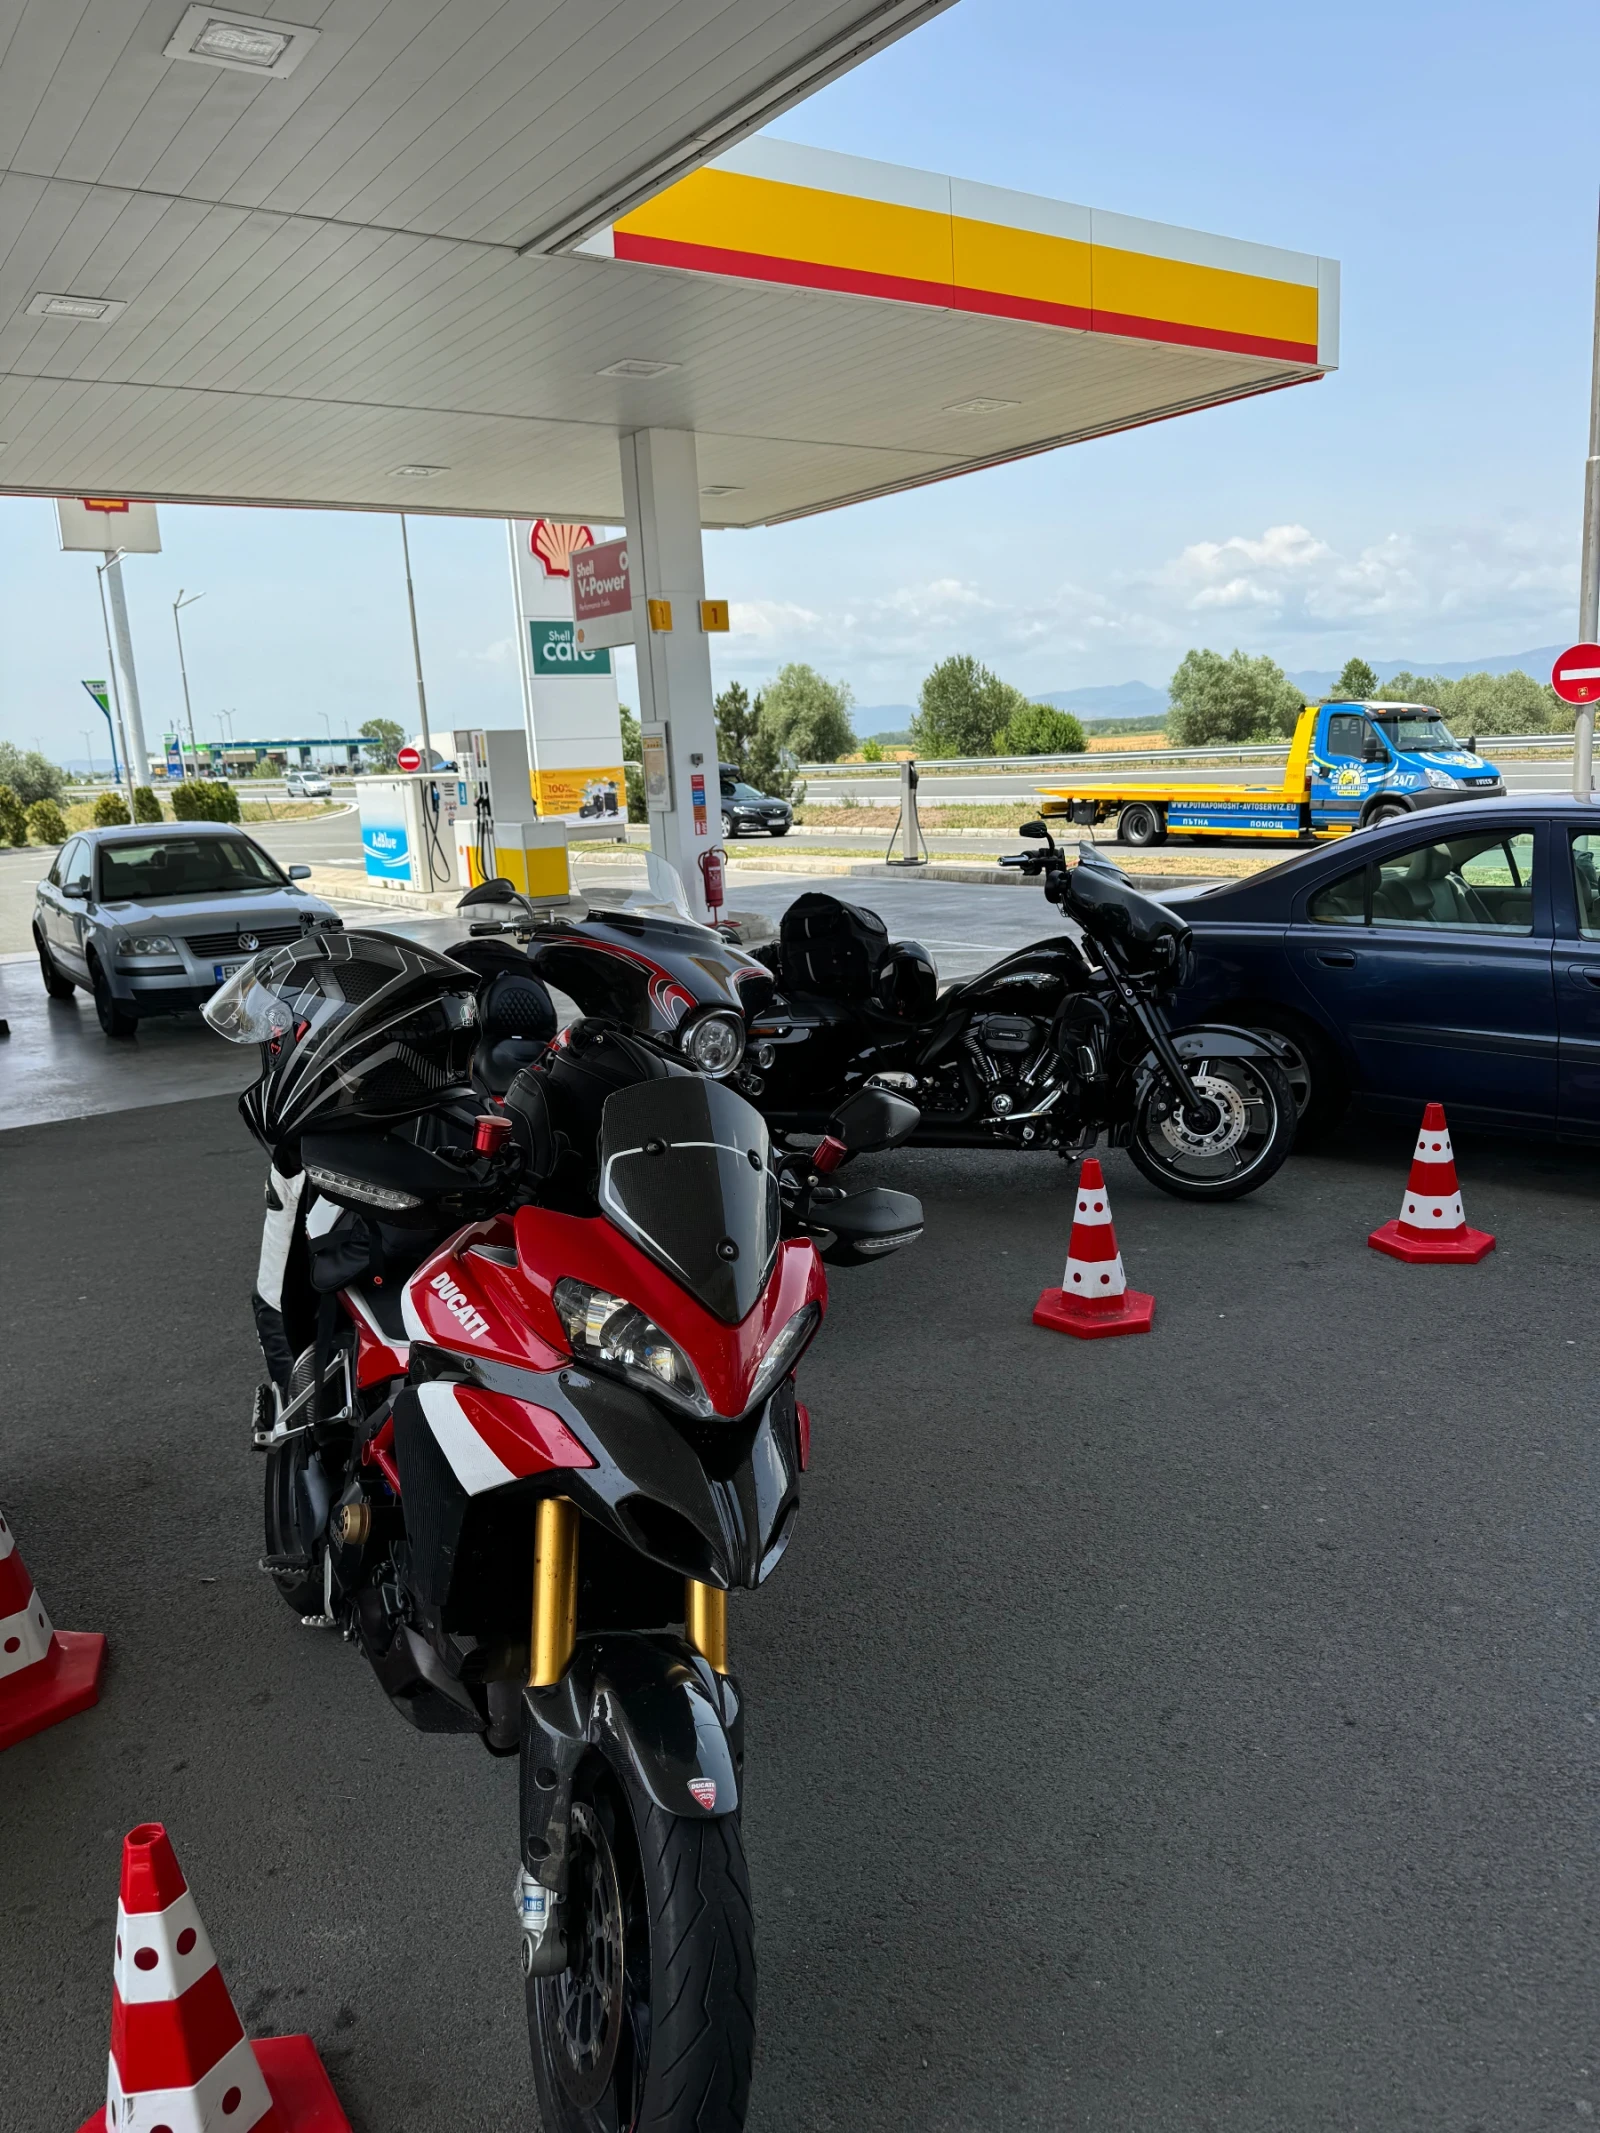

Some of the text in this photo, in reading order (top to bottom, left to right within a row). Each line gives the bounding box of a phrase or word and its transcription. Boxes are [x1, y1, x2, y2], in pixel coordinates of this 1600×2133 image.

[576, 560, 594, 578] Shell
[578, 575, 626, 598] V-Power
[711, 607, 718, 624] 1
[548, 630, 571, 641] Shell
[1393, 774, 1416, 787] 24/7
[548, 784, 572, 793] 100%
[1171, 802, 1297, 811] WWW.PUTNAPOMOSHT-AVTOSERVIZ.EU
[1182, 818, 1284, 829] ПЪТНА ПОМОЩ
[372, 832, 397, 849] AdBlue
[429, 1271, 491, 1340] DUCATI
[691, 1782, 715, 1790] DUCATI
